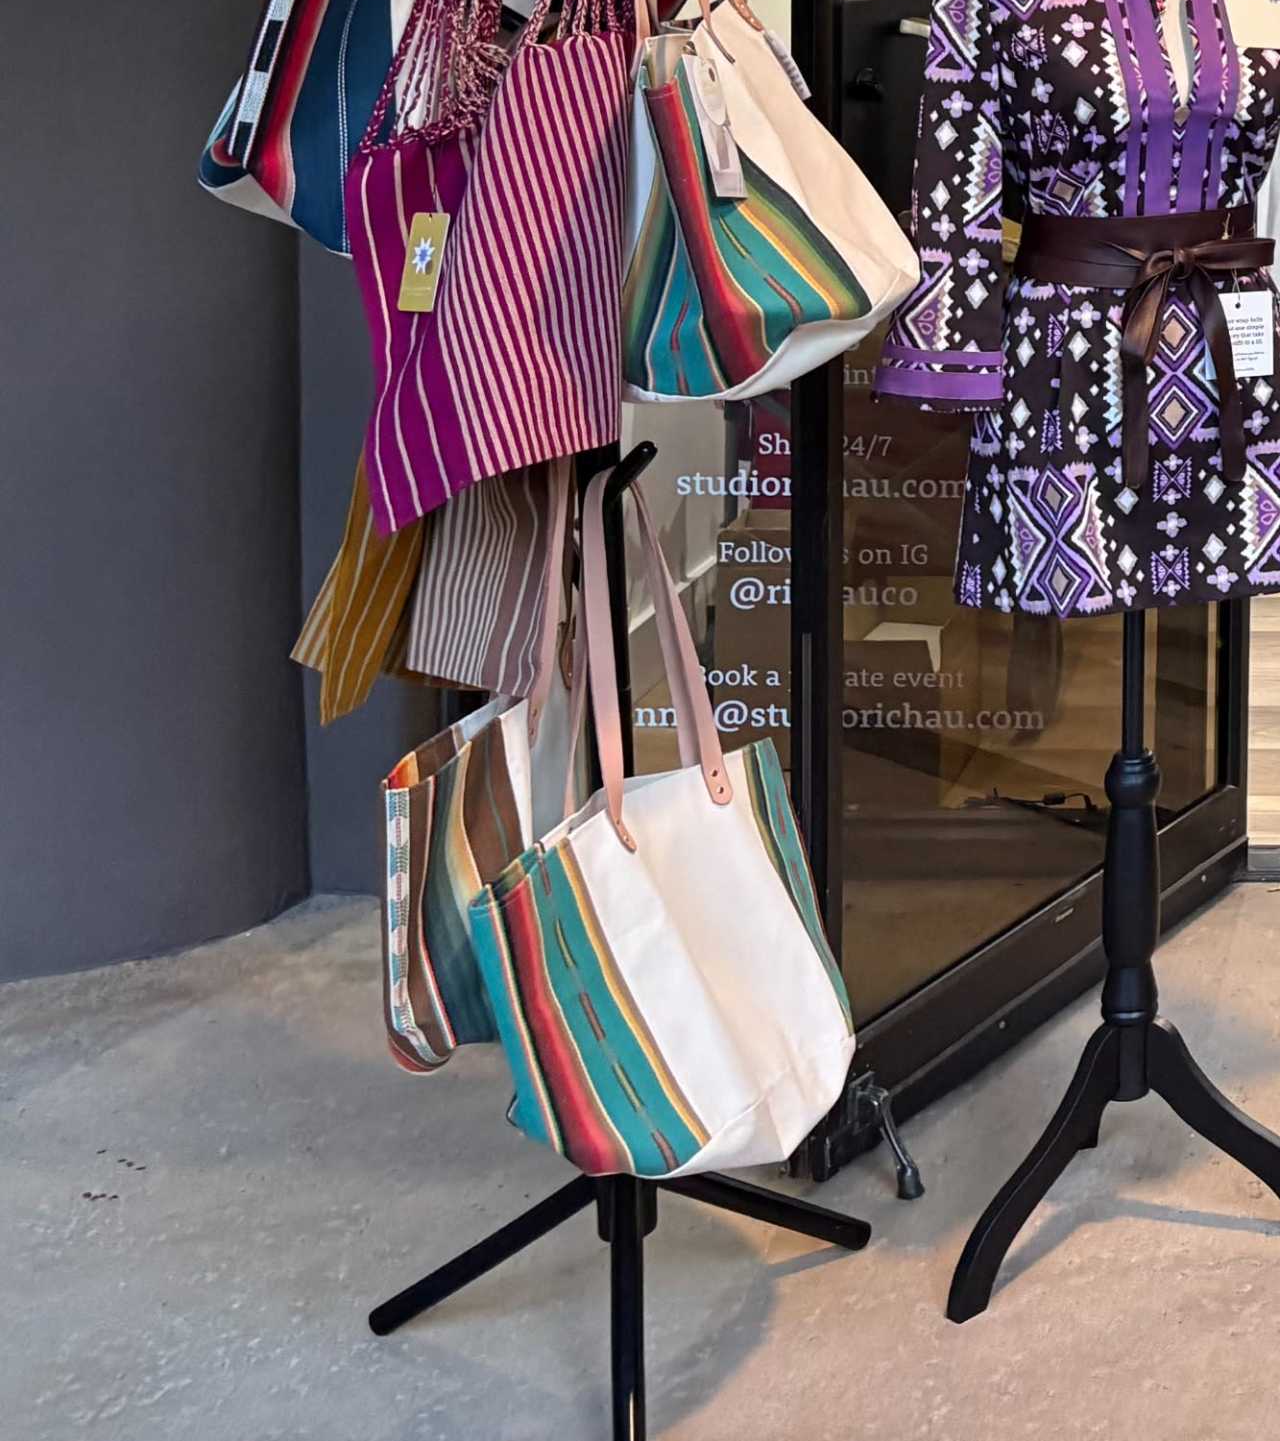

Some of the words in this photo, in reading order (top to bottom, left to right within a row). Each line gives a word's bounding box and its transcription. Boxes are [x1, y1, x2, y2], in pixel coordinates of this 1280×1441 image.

[858, 547, 893, 565] on
[900, 544, 928, 565] IG
[730, 577, 918, 610] @riauco
[766, 669, 781, 687] a
[893, 671, 965, 688] event
